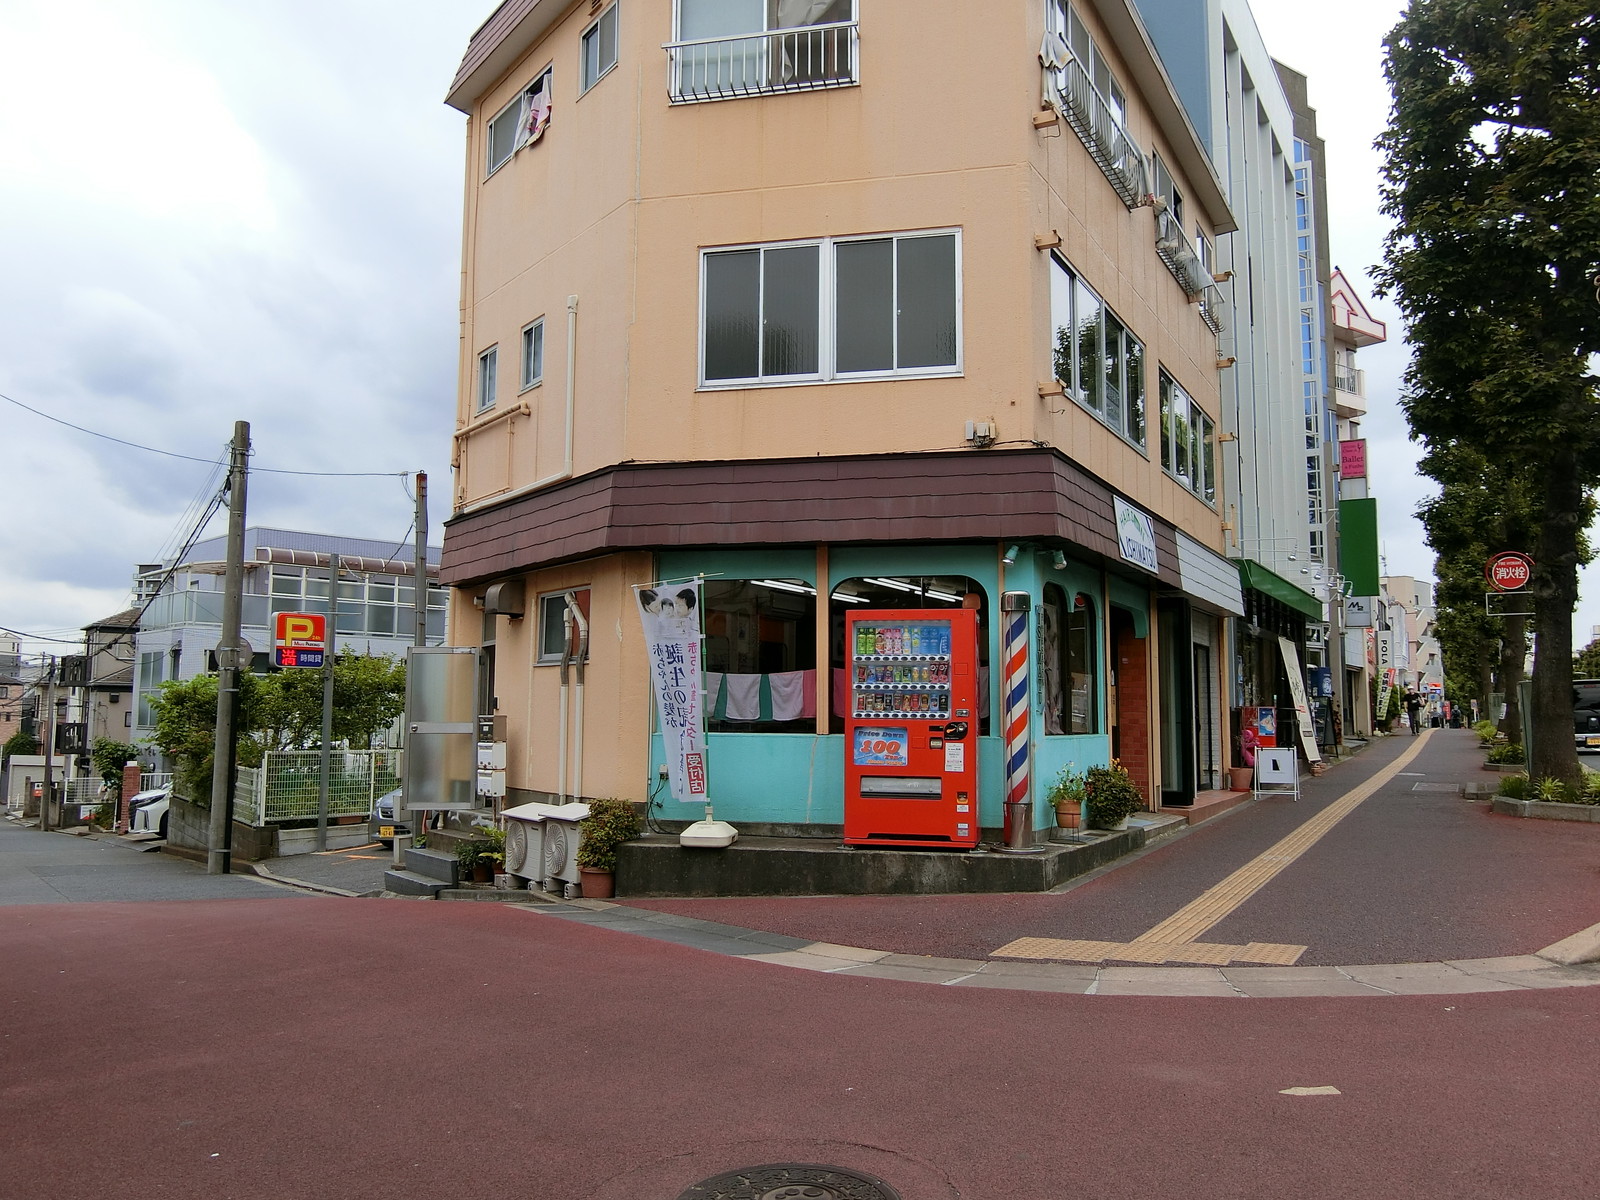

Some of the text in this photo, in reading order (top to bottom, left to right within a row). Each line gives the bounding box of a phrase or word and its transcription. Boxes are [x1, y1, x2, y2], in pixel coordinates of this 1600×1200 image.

[1496, 567, 1526, 579] 消火栓
[285, 618, 314, 647] P
[282, 649, 297, 666] 満
[860, 740, 901, 754] 100
